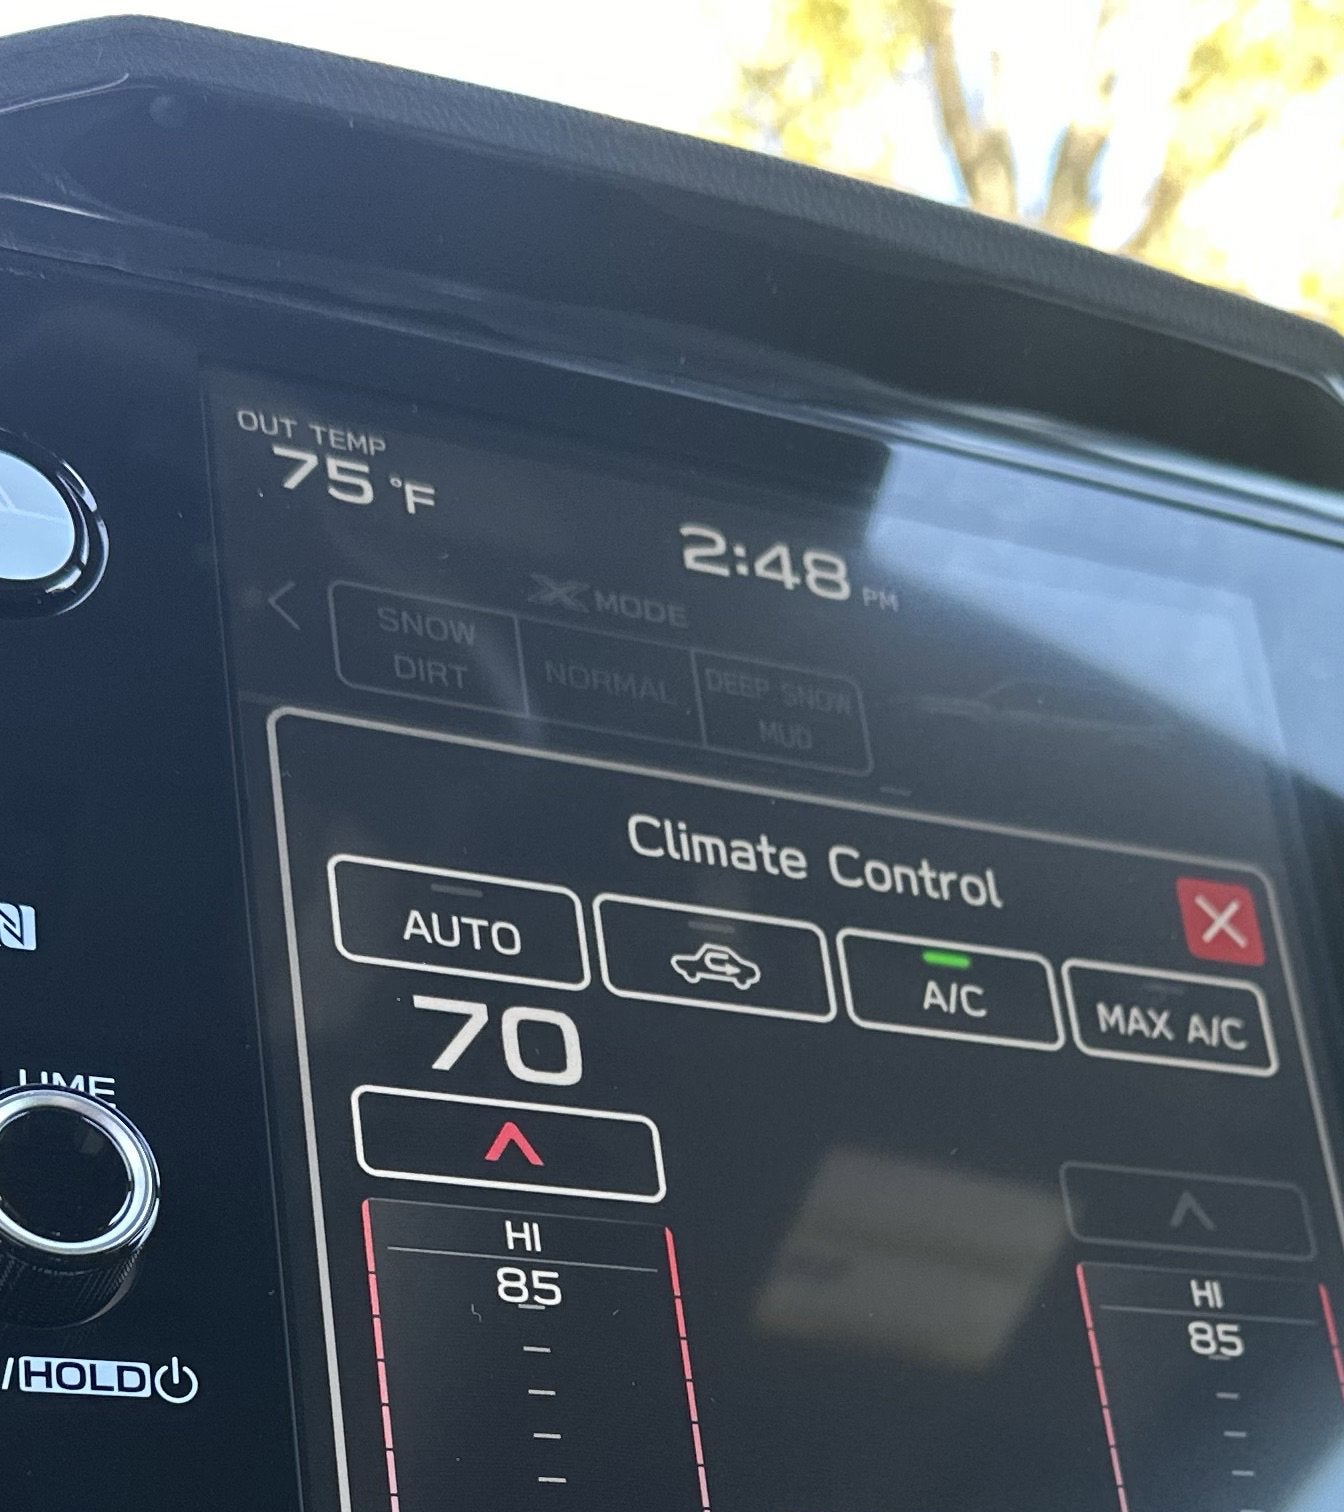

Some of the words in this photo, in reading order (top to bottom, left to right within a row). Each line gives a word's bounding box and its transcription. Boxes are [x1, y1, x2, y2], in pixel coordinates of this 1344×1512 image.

[237, 409, 298, 438] OUT
[309, 424, 386, 457] TEMP
[272, 445, 374, 506] 75
[679, 522, 852, 602] 2:48
[863, 587, 899, 614] PM
[376, 606, 477, 647] SNOW
[594, 588, 689, 630] MODE
[392, 652, 469, 690] DIRT
[545, 659, 674, 706] NORMAL
[627, 813, 808, 880] Climate
[828, 844, 1003, 909] Control
[402, 908, 524, 957] AUTO
[922, 980, 988, 1019] A/C
[412, 994, 584, 1087] 70
[1096, 1001, 1176, 1042] MAX
[1187, 1012, 1250, 1051] A/C
[504, 1220, 543, 1253] HI
[497, 1266, 563, 1307] 85
[1189, 1279, 1225, 1310] HI
[1187, 1320, 1245, 1359] 85
